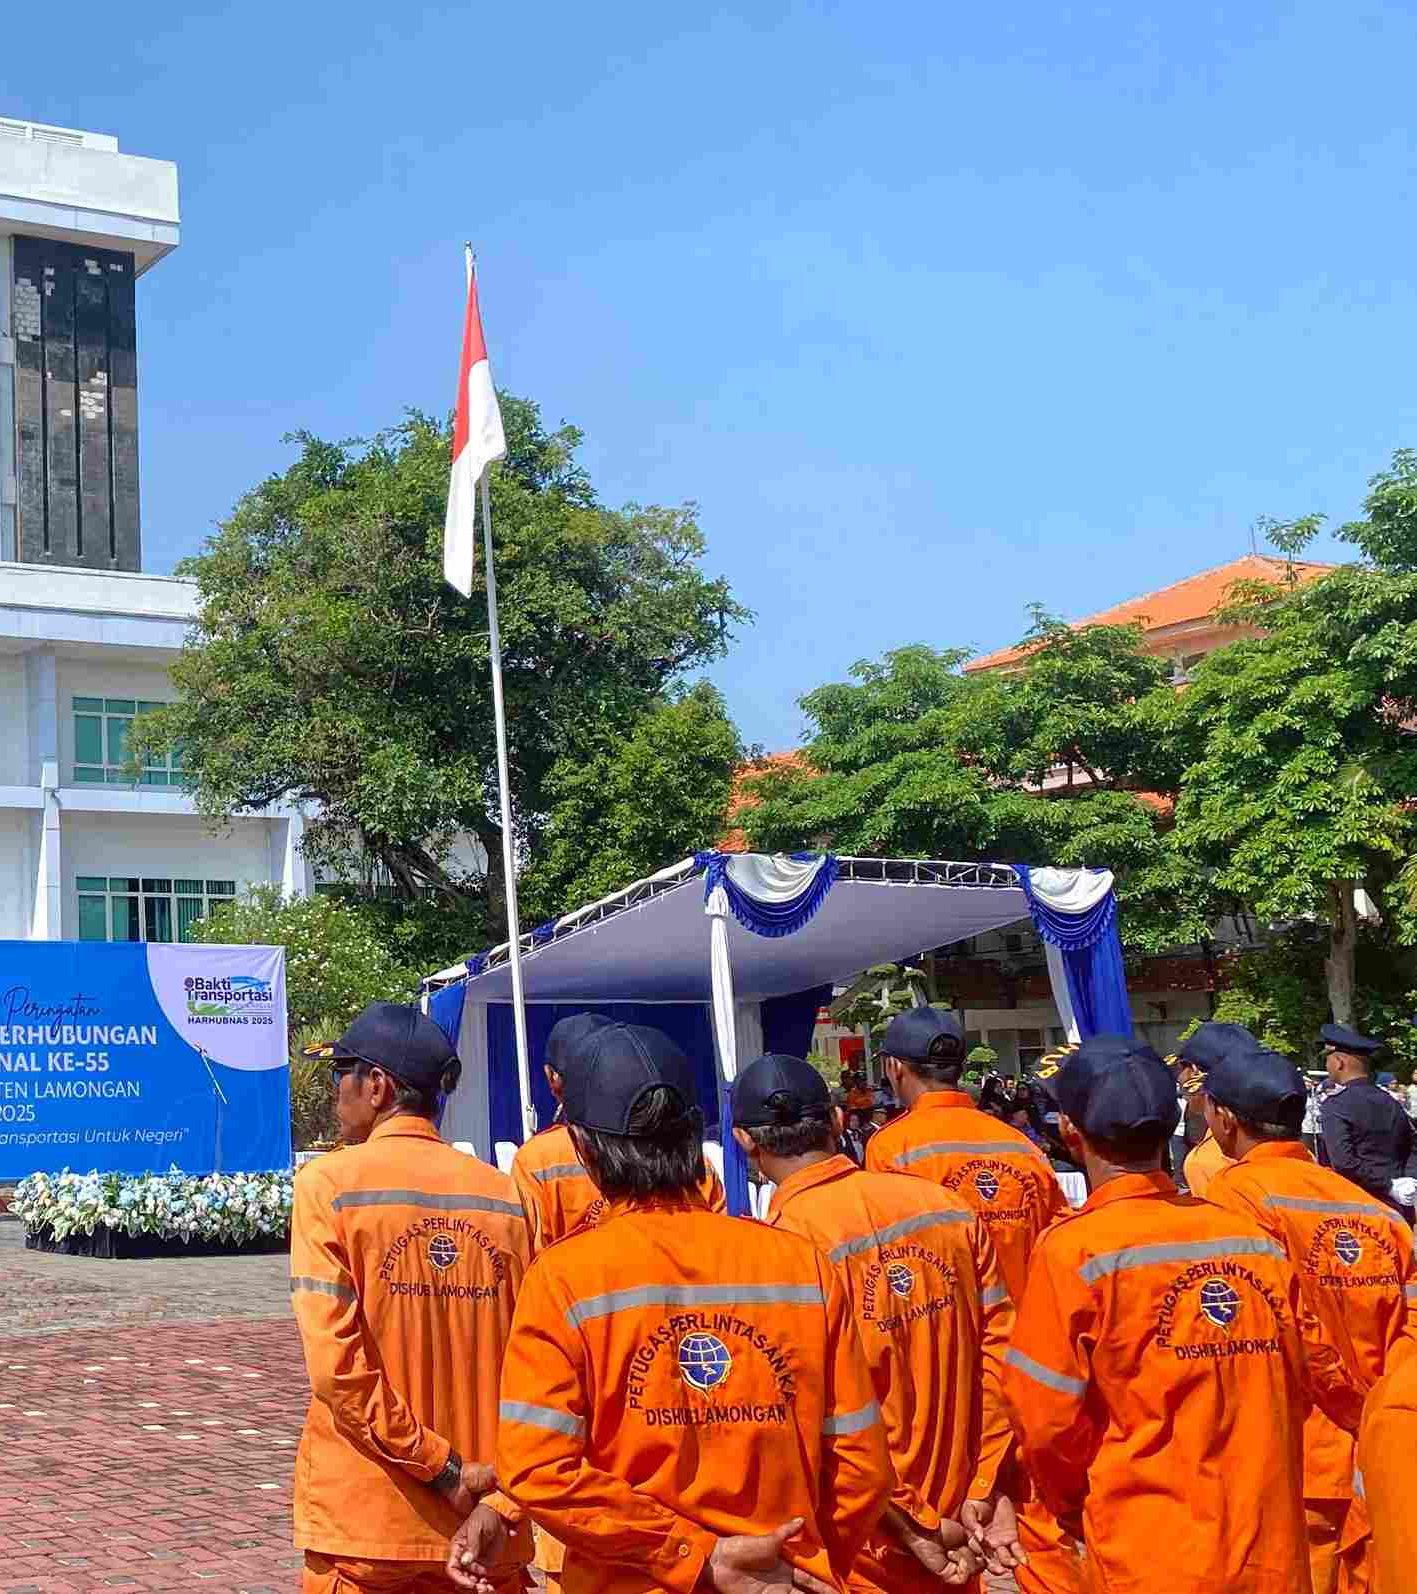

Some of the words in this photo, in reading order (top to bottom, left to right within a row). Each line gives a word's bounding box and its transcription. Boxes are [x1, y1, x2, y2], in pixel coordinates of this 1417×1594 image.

[195, 976, 231, 990] Bakti
[187, 987, 272, 1004] Transportasi
[251, 1016, 273, 1025] 2025
[48, 1052, 110, 1072] KE-55
[34, 1081, 141, 1098] LAMONGAN
[85, 1129, 130, 1144] Untuk
[436, 1285, 498, 1299] LAMONGAN
[629, 1325, 673, 1410] PETUGAS
[695, 1404, 787, 1425] LAMONGAN
